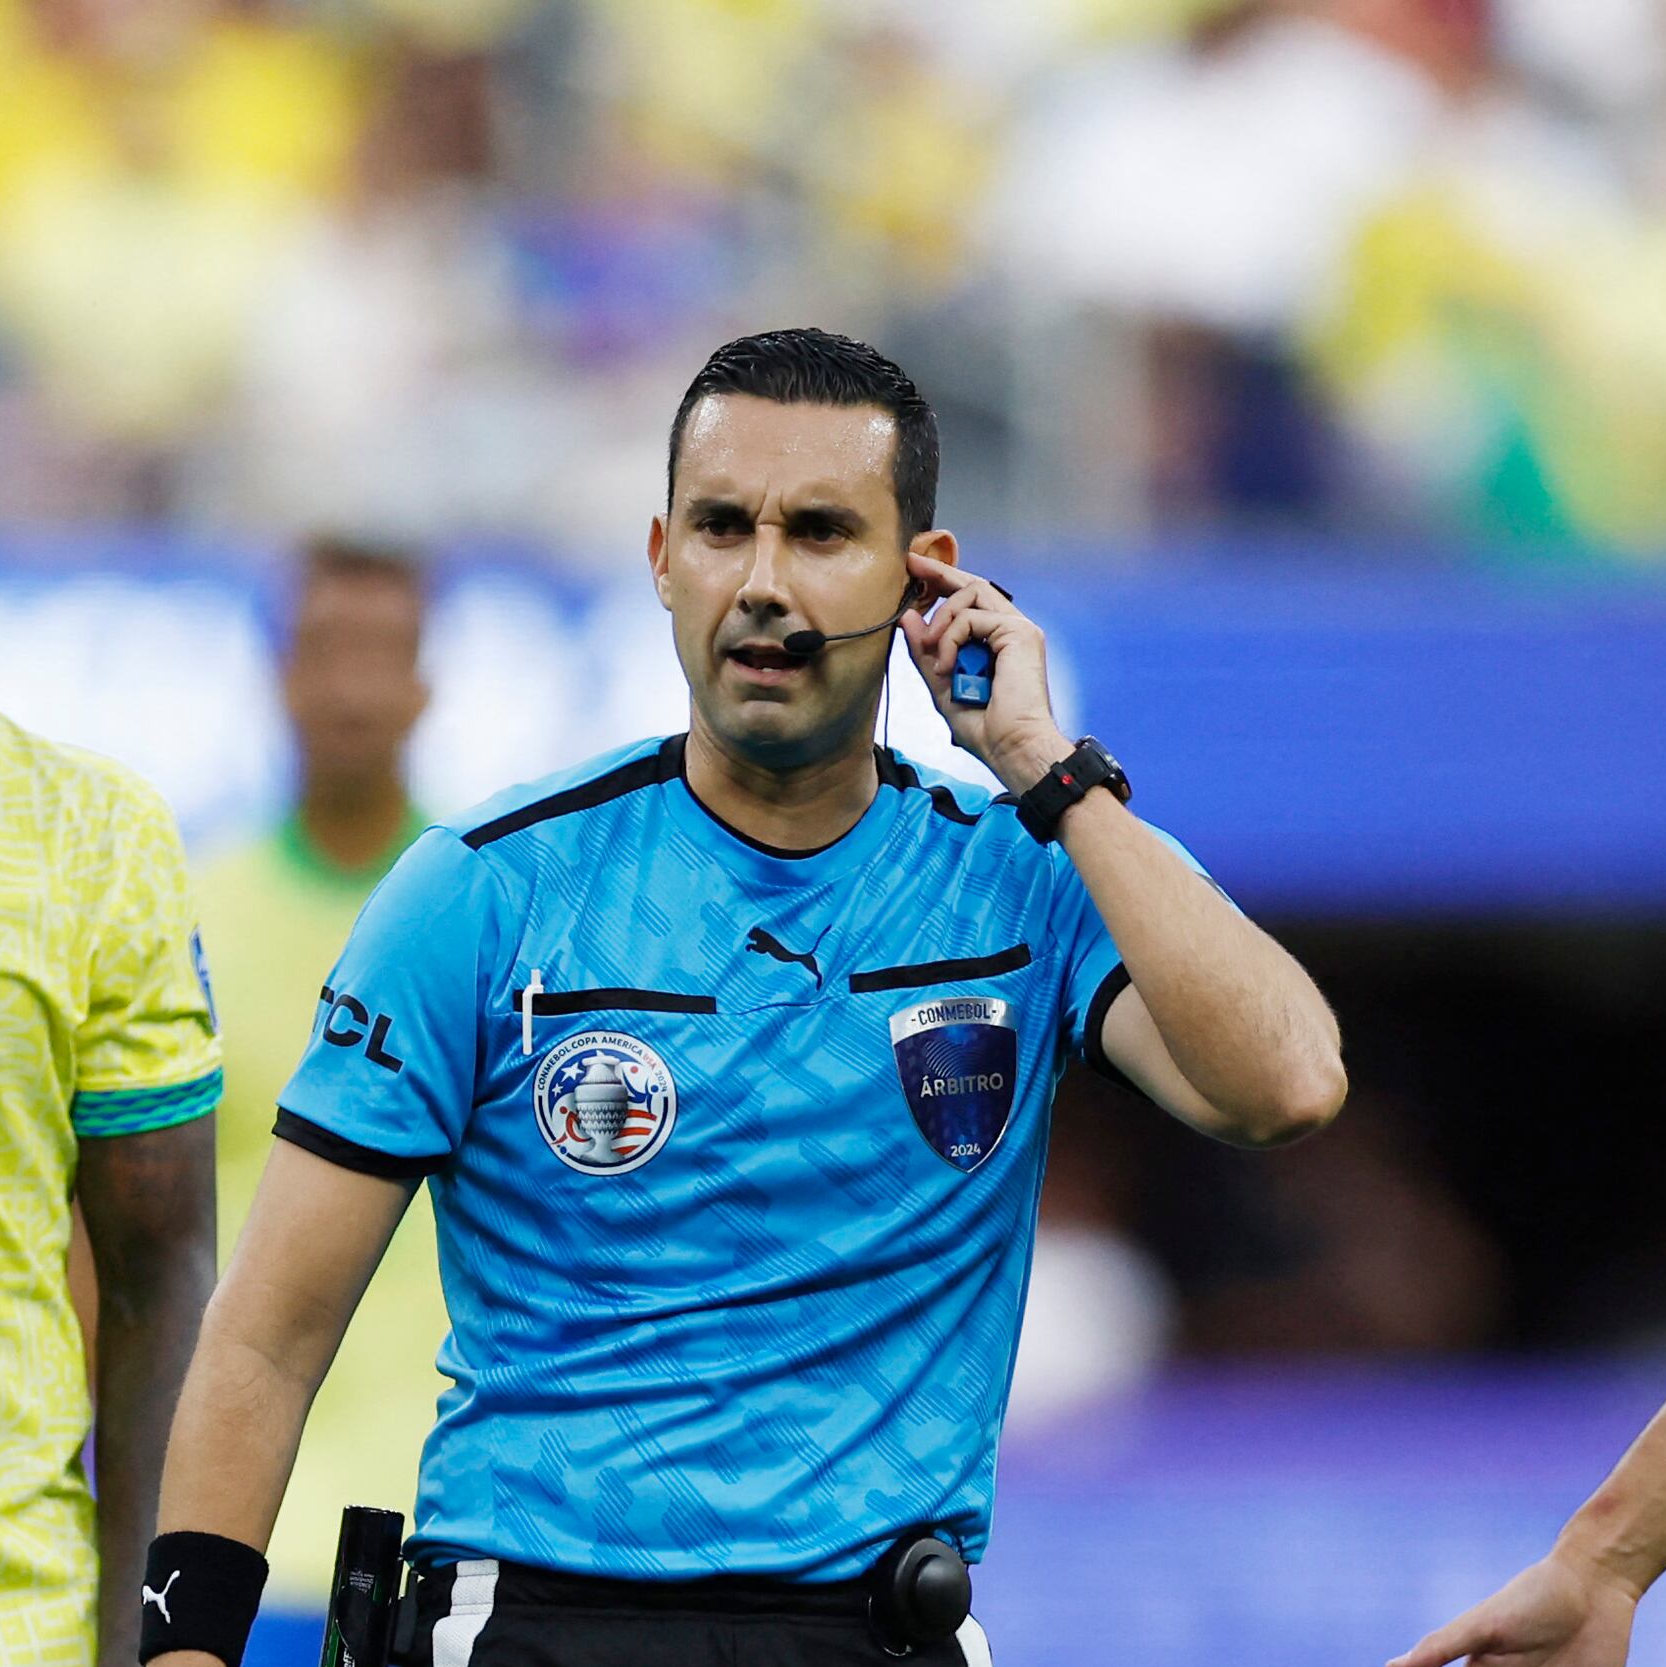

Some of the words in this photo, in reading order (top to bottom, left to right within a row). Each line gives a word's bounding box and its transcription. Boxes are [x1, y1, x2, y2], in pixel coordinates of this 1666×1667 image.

[537, 1045, 571, 1091] CONMEBOL
[571, 1036, 598, 1049] COPA
[601, 1035, 643, 1057] AMERICA
[642, 1052, 656, 1071] USA
[654, 1069, 668, 1093] 2024
[920, 1072, 1004, 1098] ÁRBITRO
[950, 1142, 982, 1158] 2024
